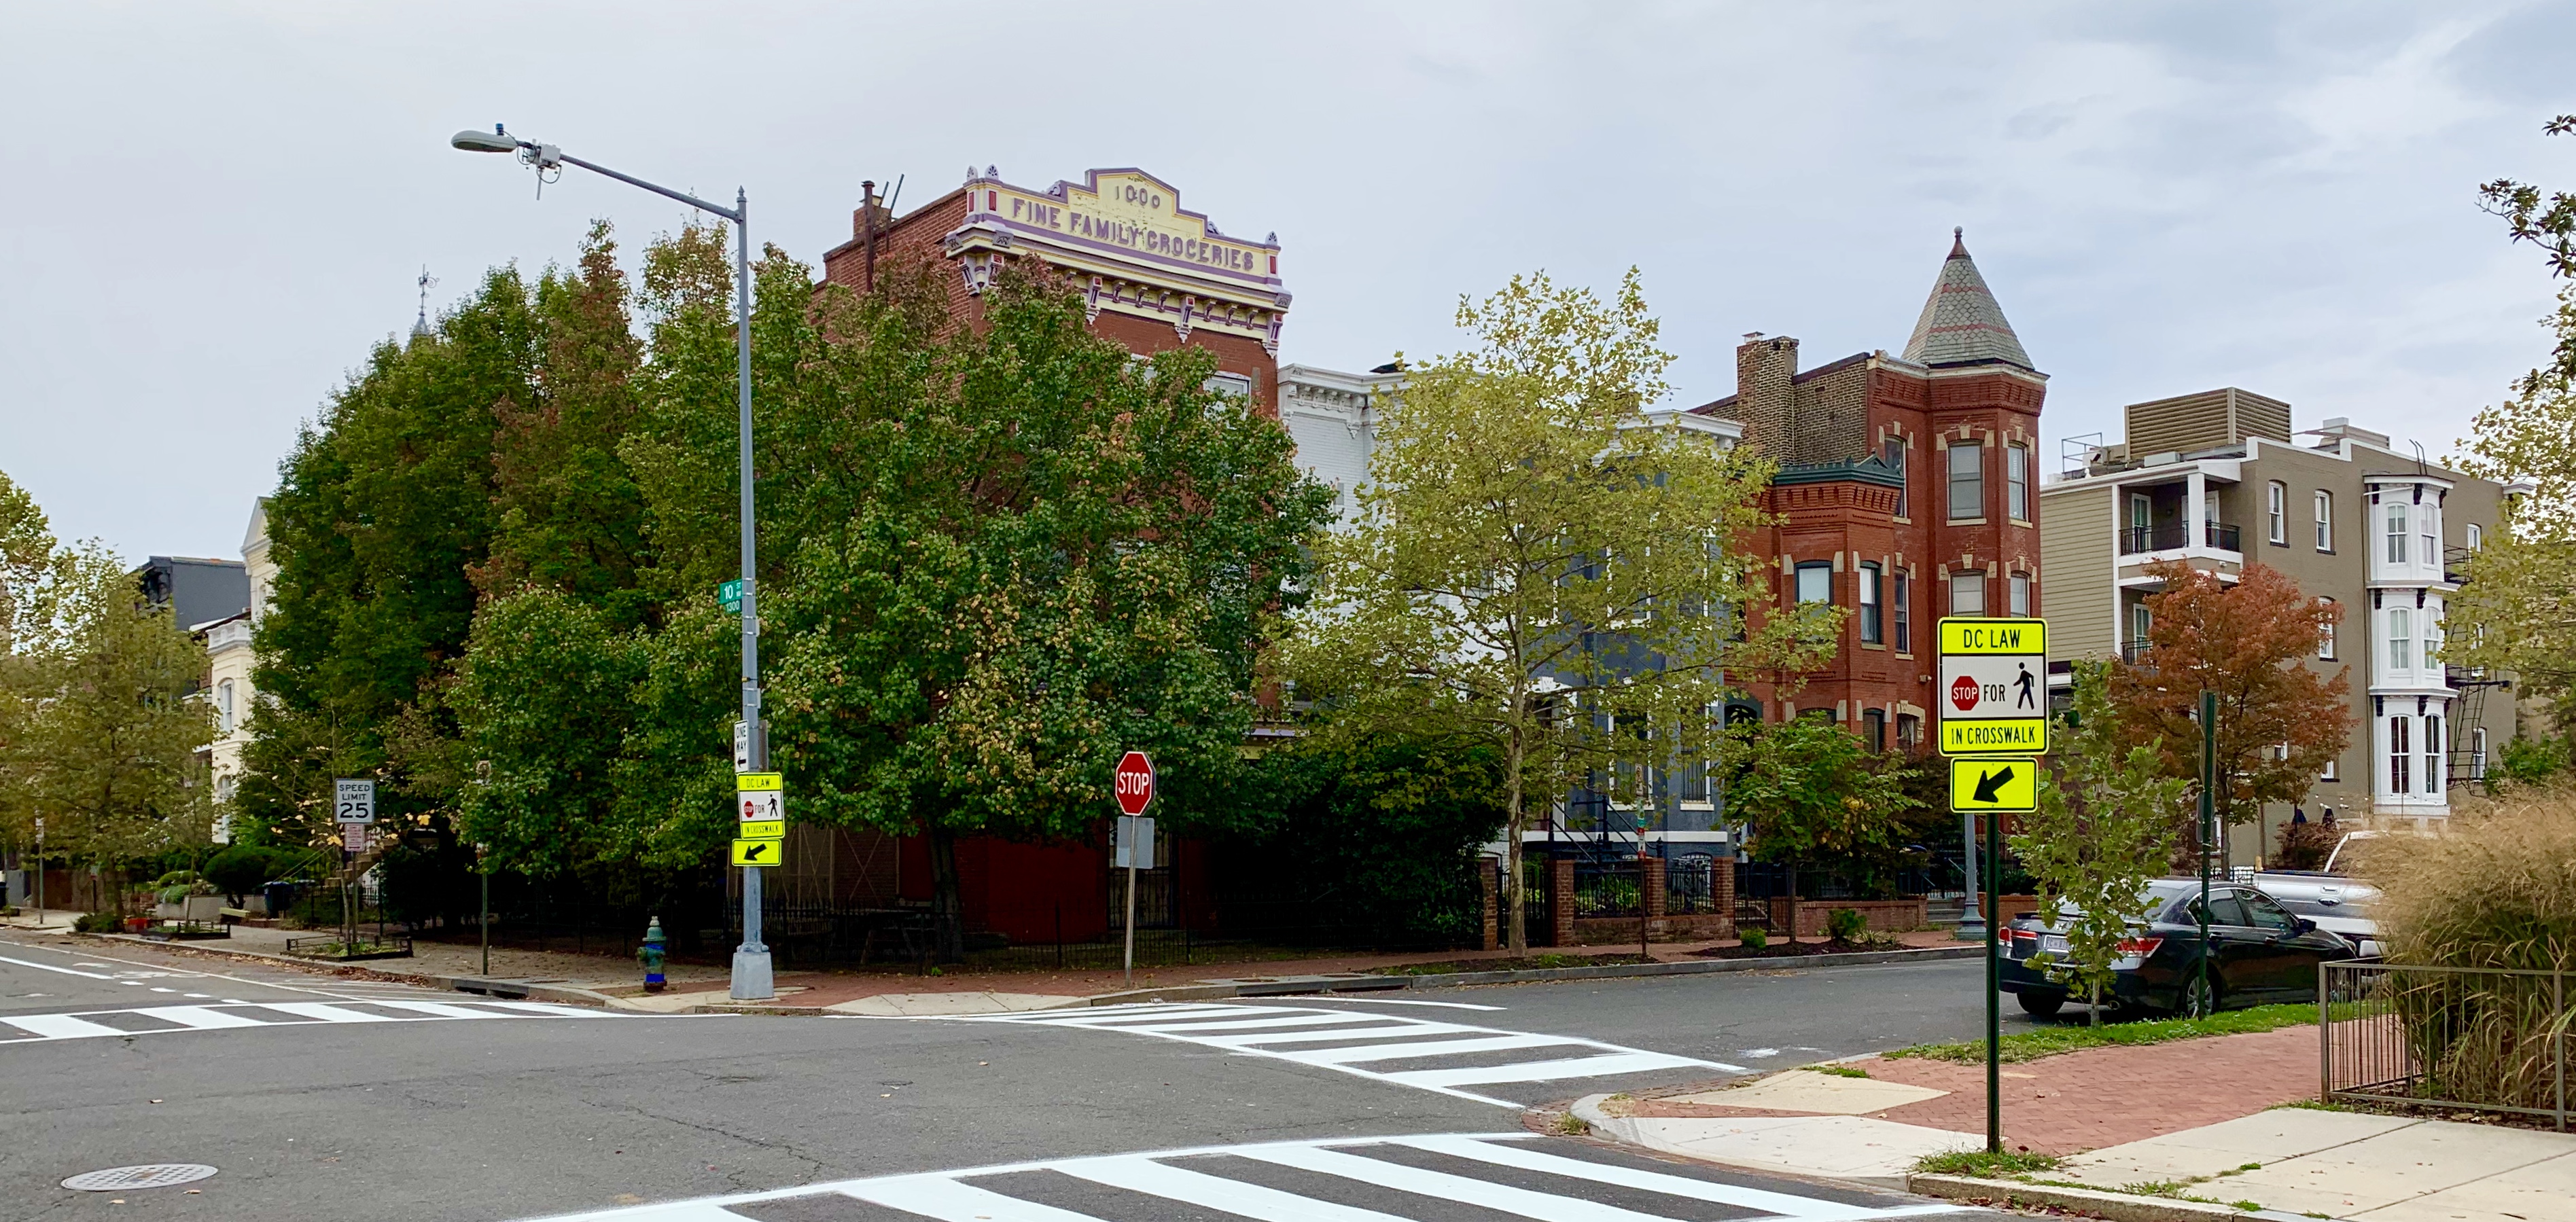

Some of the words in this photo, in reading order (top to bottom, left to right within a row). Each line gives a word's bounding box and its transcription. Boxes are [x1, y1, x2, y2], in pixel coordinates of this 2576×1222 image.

[1116, 185, 1161, 209] 1000
[1012, 198, 1061, 228] FINE
[1070, 212, 1139, 246] FAMILY
[1146, 230, 1254, 270] GROCERIES
[724, 585, 733, 600] 10
[726, 600, 740, 612] 1300
[1964, 629, 1983, 648] DC
[1990, 629, 2020, 648] LAW
[1953, 687, 1978, 700] STOP
[1983, 685, 2006, 702] FOR
[736, 725, 747, 739] ONE
[1952, 727, 1962, 744] IN
[1967, 727, 2035, 744] CROSSWALK
[736, 740, 747, 753] WAY
[746, 778, 755, 788] DC
[757, 778, 771, 788] LAW
[1118, 772, 1150, 795] STOP
[340, 803, 368, 819] 25
[754, 804, 765, 814] FOR
[745, 825, 749, 834] IN
[750, 824, 779, 834] CROSSWALK
